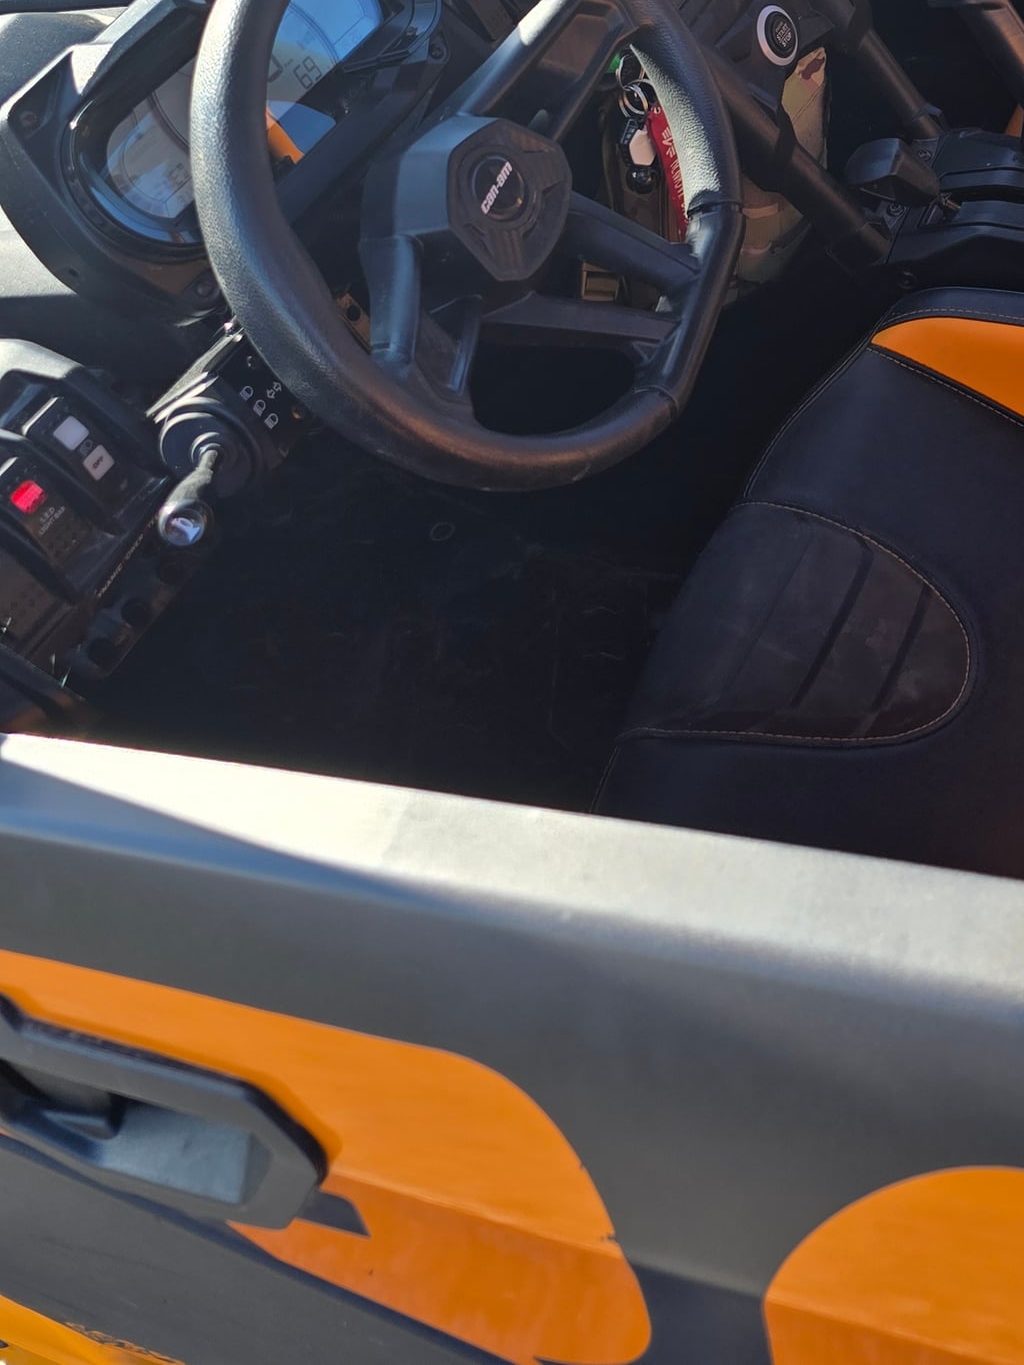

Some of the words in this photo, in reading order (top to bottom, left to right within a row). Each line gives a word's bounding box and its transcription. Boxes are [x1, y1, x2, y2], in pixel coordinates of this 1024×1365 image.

[776, 22, 790, 42] START
[781, 31, 793, 48] STOP
[293, 55, 323, 90] 69
[480, 161, 513, 215] can-am
[91, 455, 104, 470] OFF
